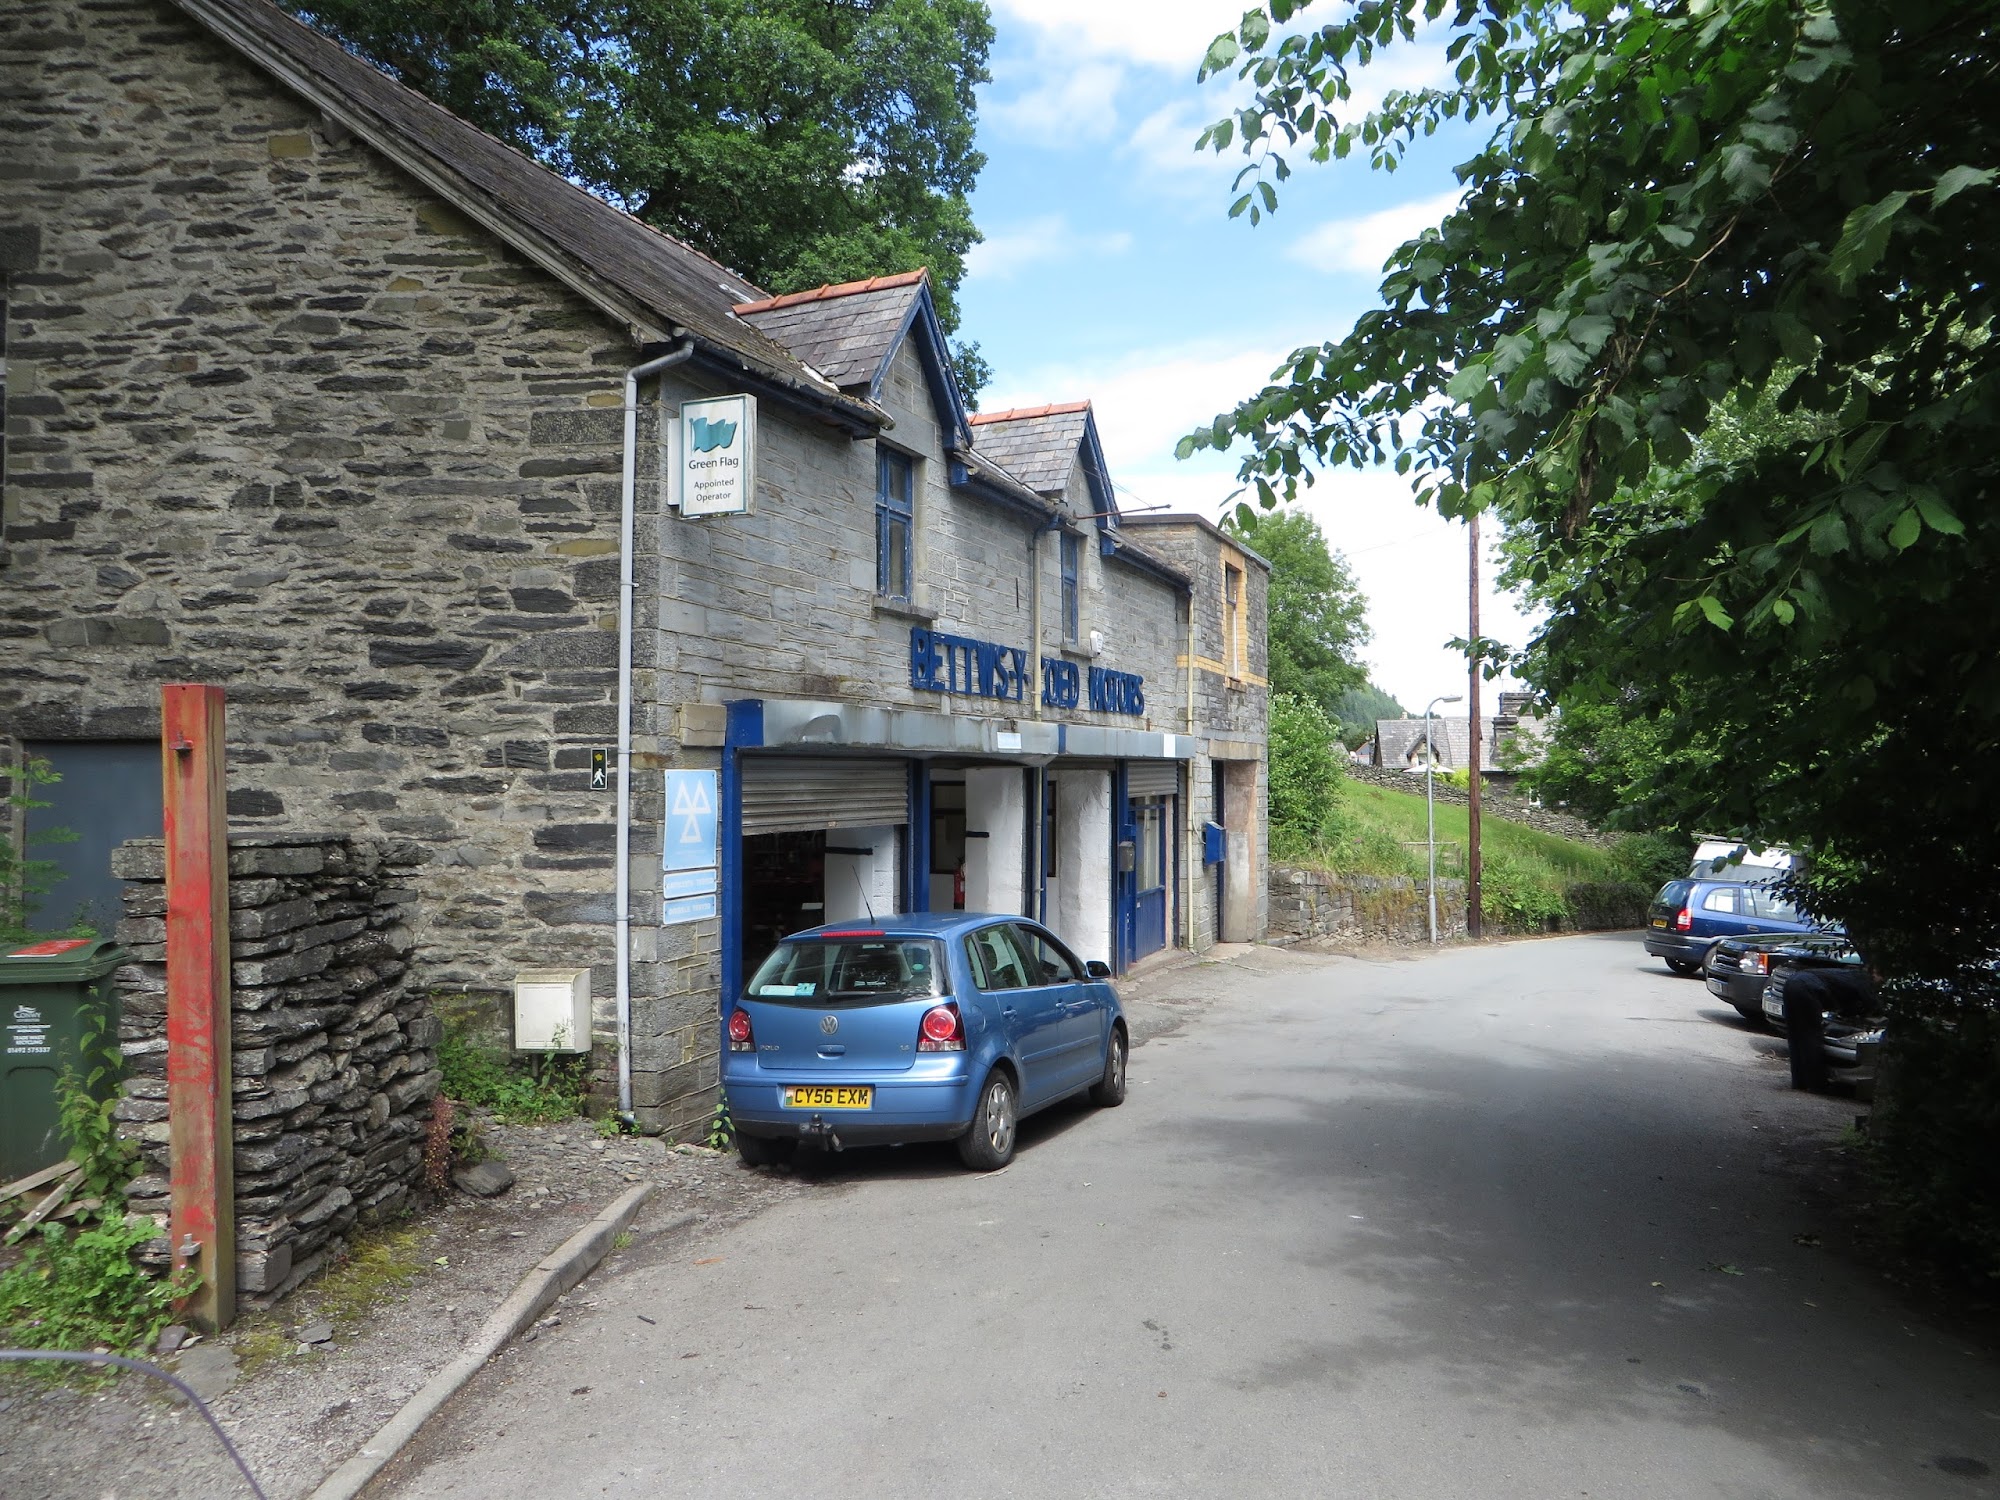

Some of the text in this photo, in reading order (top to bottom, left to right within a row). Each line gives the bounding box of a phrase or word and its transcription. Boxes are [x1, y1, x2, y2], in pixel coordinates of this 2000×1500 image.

[688, 457, 739, 470] Green Flag
[694, 478, 734, 490] Appointed
[696, 492, 731, 503] Operator
[1088, 665, 1145, 716] MOTORS
[795, 1088, 868, 1105] CY56 EXM
